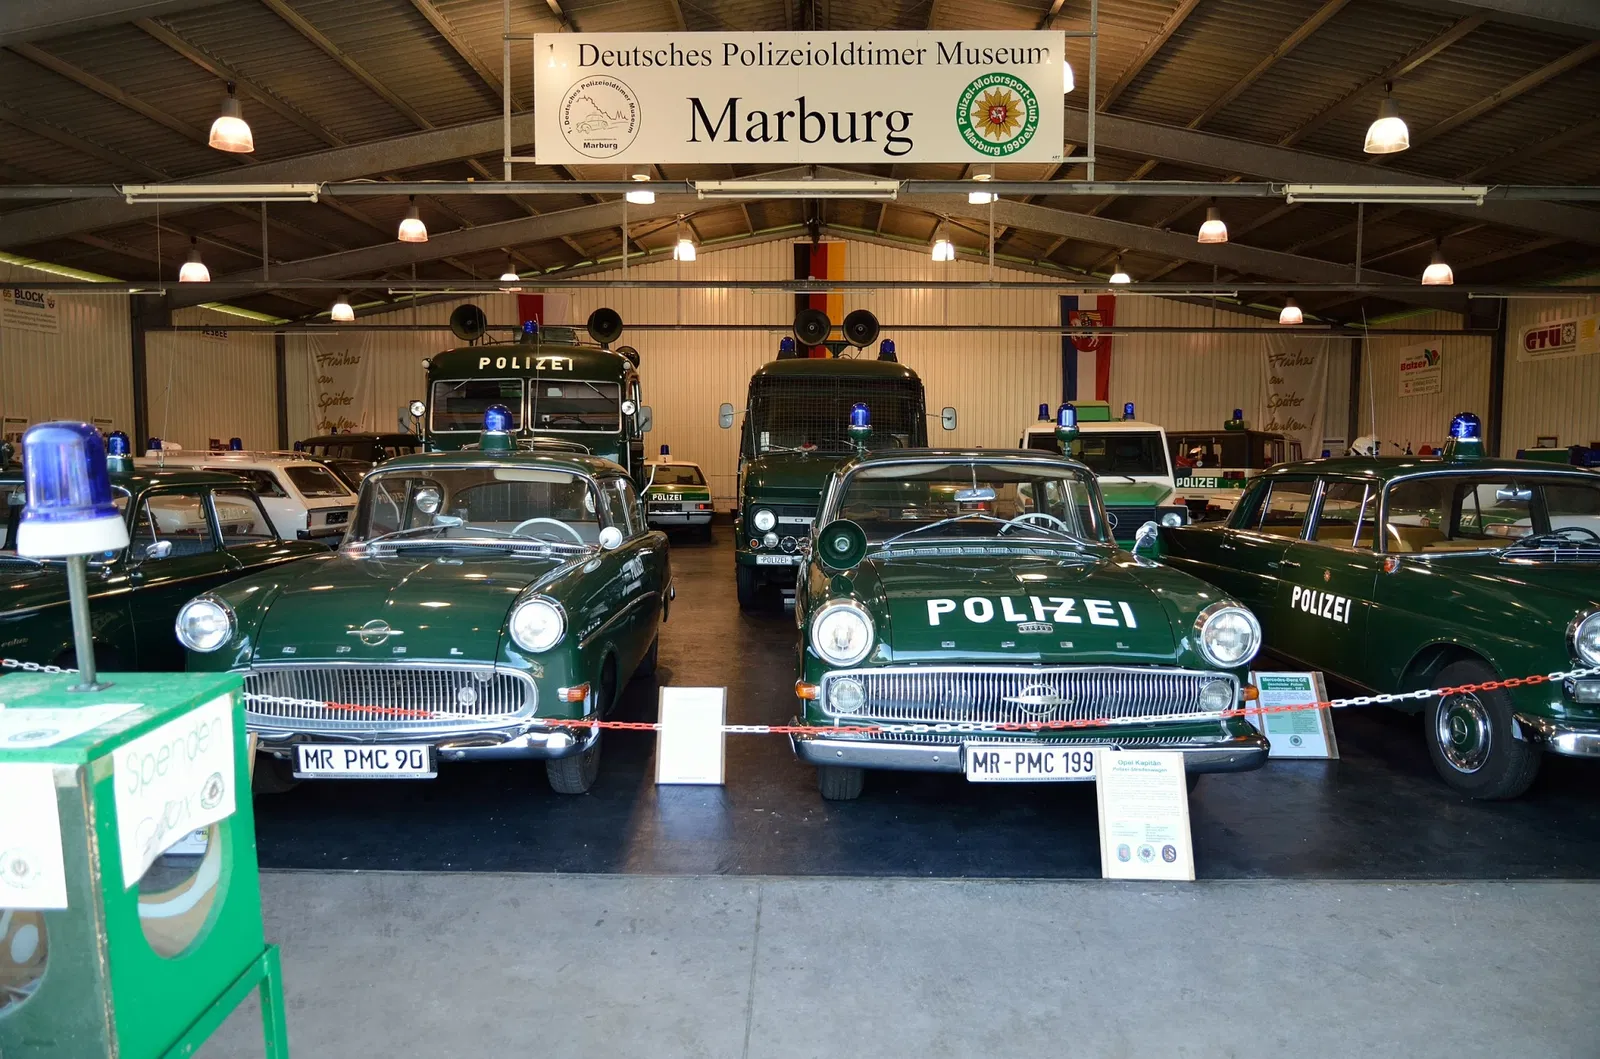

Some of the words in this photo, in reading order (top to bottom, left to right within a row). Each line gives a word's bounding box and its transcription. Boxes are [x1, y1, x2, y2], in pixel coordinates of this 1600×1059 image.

[577, 42, 712, 67] Deutsches
[721, 41, 927, 67] Polizeioldtimer
[936, 41, 1053, 65] Museum
[564, 88, 581, 126] Deutsches
[580, 80, 631, 101] Polizeioldtimer
[627, 102, 636, 134] Museum
[685, 95, 914, 157] Marburg
[583, 142, 618, 150] Marburg
[963, 127, 1002, 156] Marburg
[14, 289, 45, 303] BLOCK
[1525, 325, 1561, 350] GTÜ
[479, 357, 574, 371] POLIZEI
[317, 391, 355, 413] Später
[1266, 392, 1305, 414] Später
[1176, 477, 1218, 488] POLIZEI
[652, 493, 682, 501] POLIZEI
[926, 596, 1138, 629] POLIZEI
[1291, 585, 1352, 624] POLIZEI
[126, 716, 225, 797] Spenden
[304, 749, 334, 769] MR
[344, 749, 389, 769] PMC
[395, 749, 423, 769] 90
[1062, 751, 1094, 774] 199
[1135, 759, 1162, 767] Kapitän
